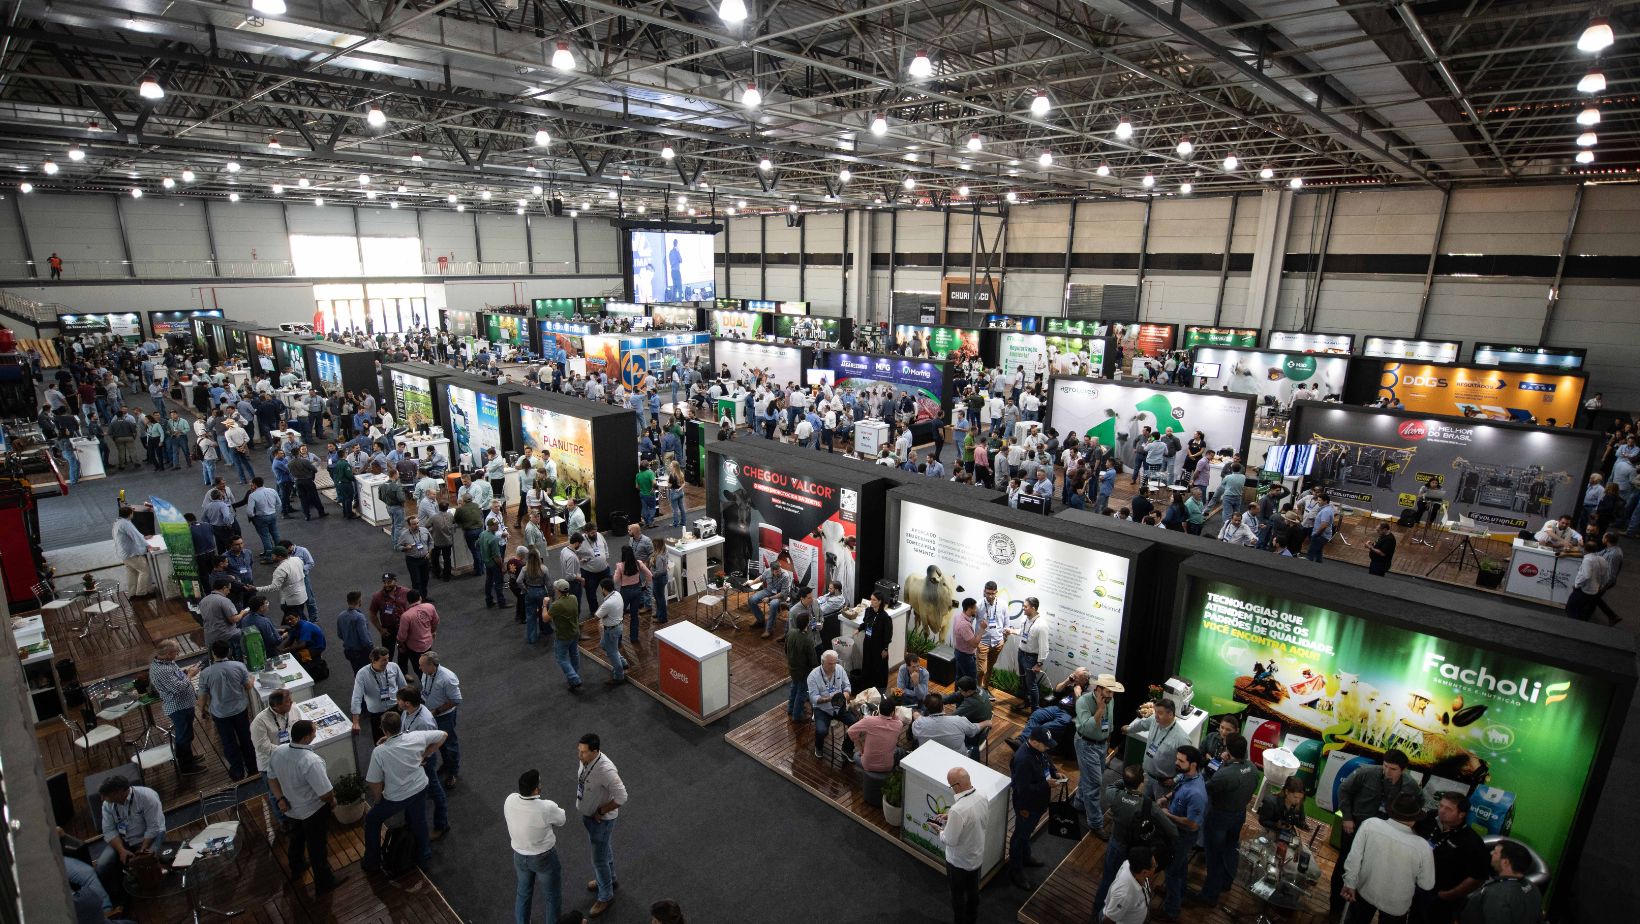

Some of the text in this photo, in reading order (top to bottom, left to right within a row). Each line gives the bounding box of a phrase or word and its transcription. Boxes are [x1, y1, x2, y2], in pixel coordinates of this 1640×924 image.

[951, 292, 989, 301] CHURCO
[722, 316, 748, 328] DUAL
[910, 368, 930, 378] Marfrig
[1402, 375, 1448, 388] DDGS
[1438, 426, 1474, 435] MELHOR
[1442, 434, 1472, 442] BRASIL
[544, 436, 584, 456] PLANUTRE
[744, 465, 832, 500] CHEGOU VALCOR
[1207, 592, 1304, 626] TECNOLOGIAS QUE
[1205, 602, 1309, 637] ATENDEM TODOS OS
[1203, 620, 1231, 634] VOCÊ
[1231, 628, 1287, 652] ENCONTRA
[1204, 612, 1336, 656] PADRÕES DE QUALIDADE,
[669, 668, 689, 684] zoetis
[1423, 652, 1542, 703] Facholi
[1482, 692, 1521, 706] NUTRIÇÃO
[1470, 805, 1499, 820] integra
